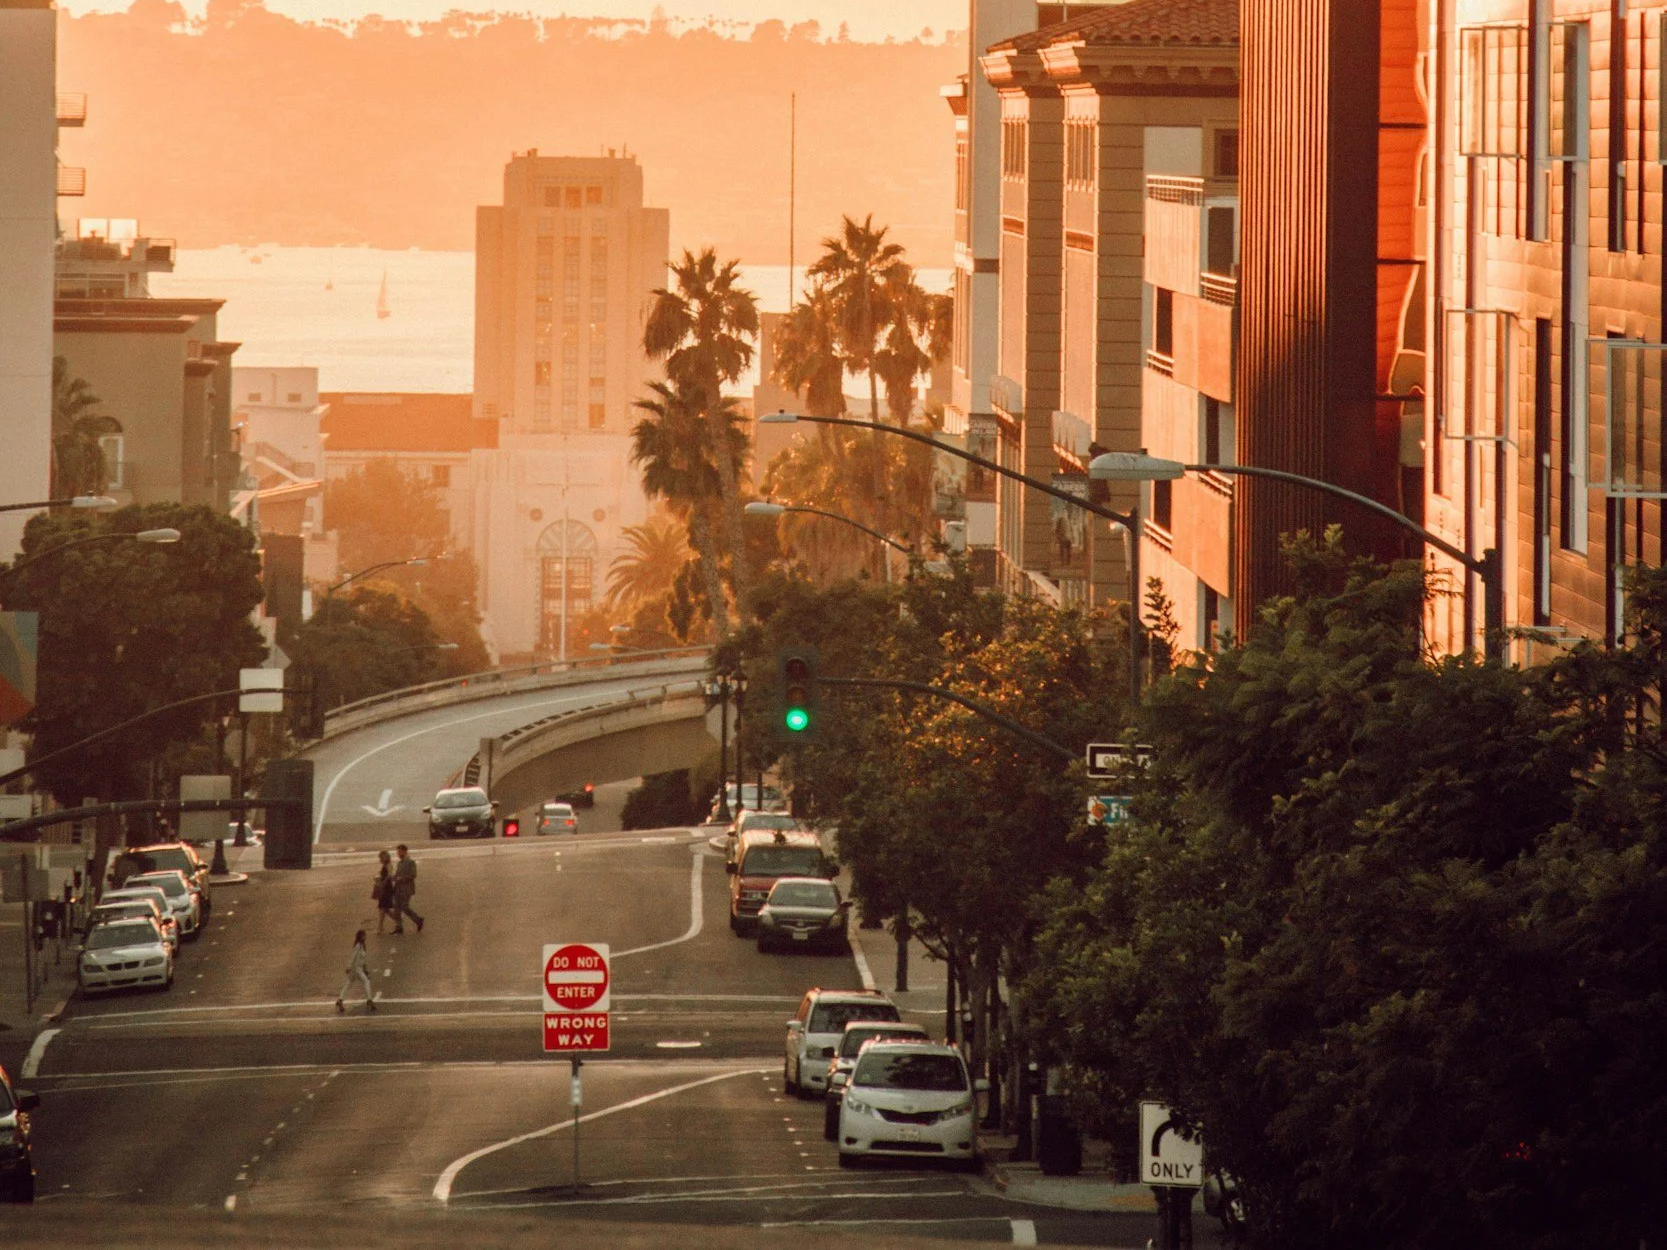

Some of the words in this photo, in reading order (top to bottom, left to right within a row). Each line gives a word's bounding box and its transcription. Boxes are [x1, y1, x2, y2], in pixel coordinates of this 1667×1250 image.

[553, 956, 569, 968] DO
[576, 956, 600, 968] NOT
[557, 986, 596, 999] ENTER
[546, 1017, 607, 1030] WRONG
[557, 1034, 594, 1046] WAY
[1151, 1161, 1194, 1179] ONLY
